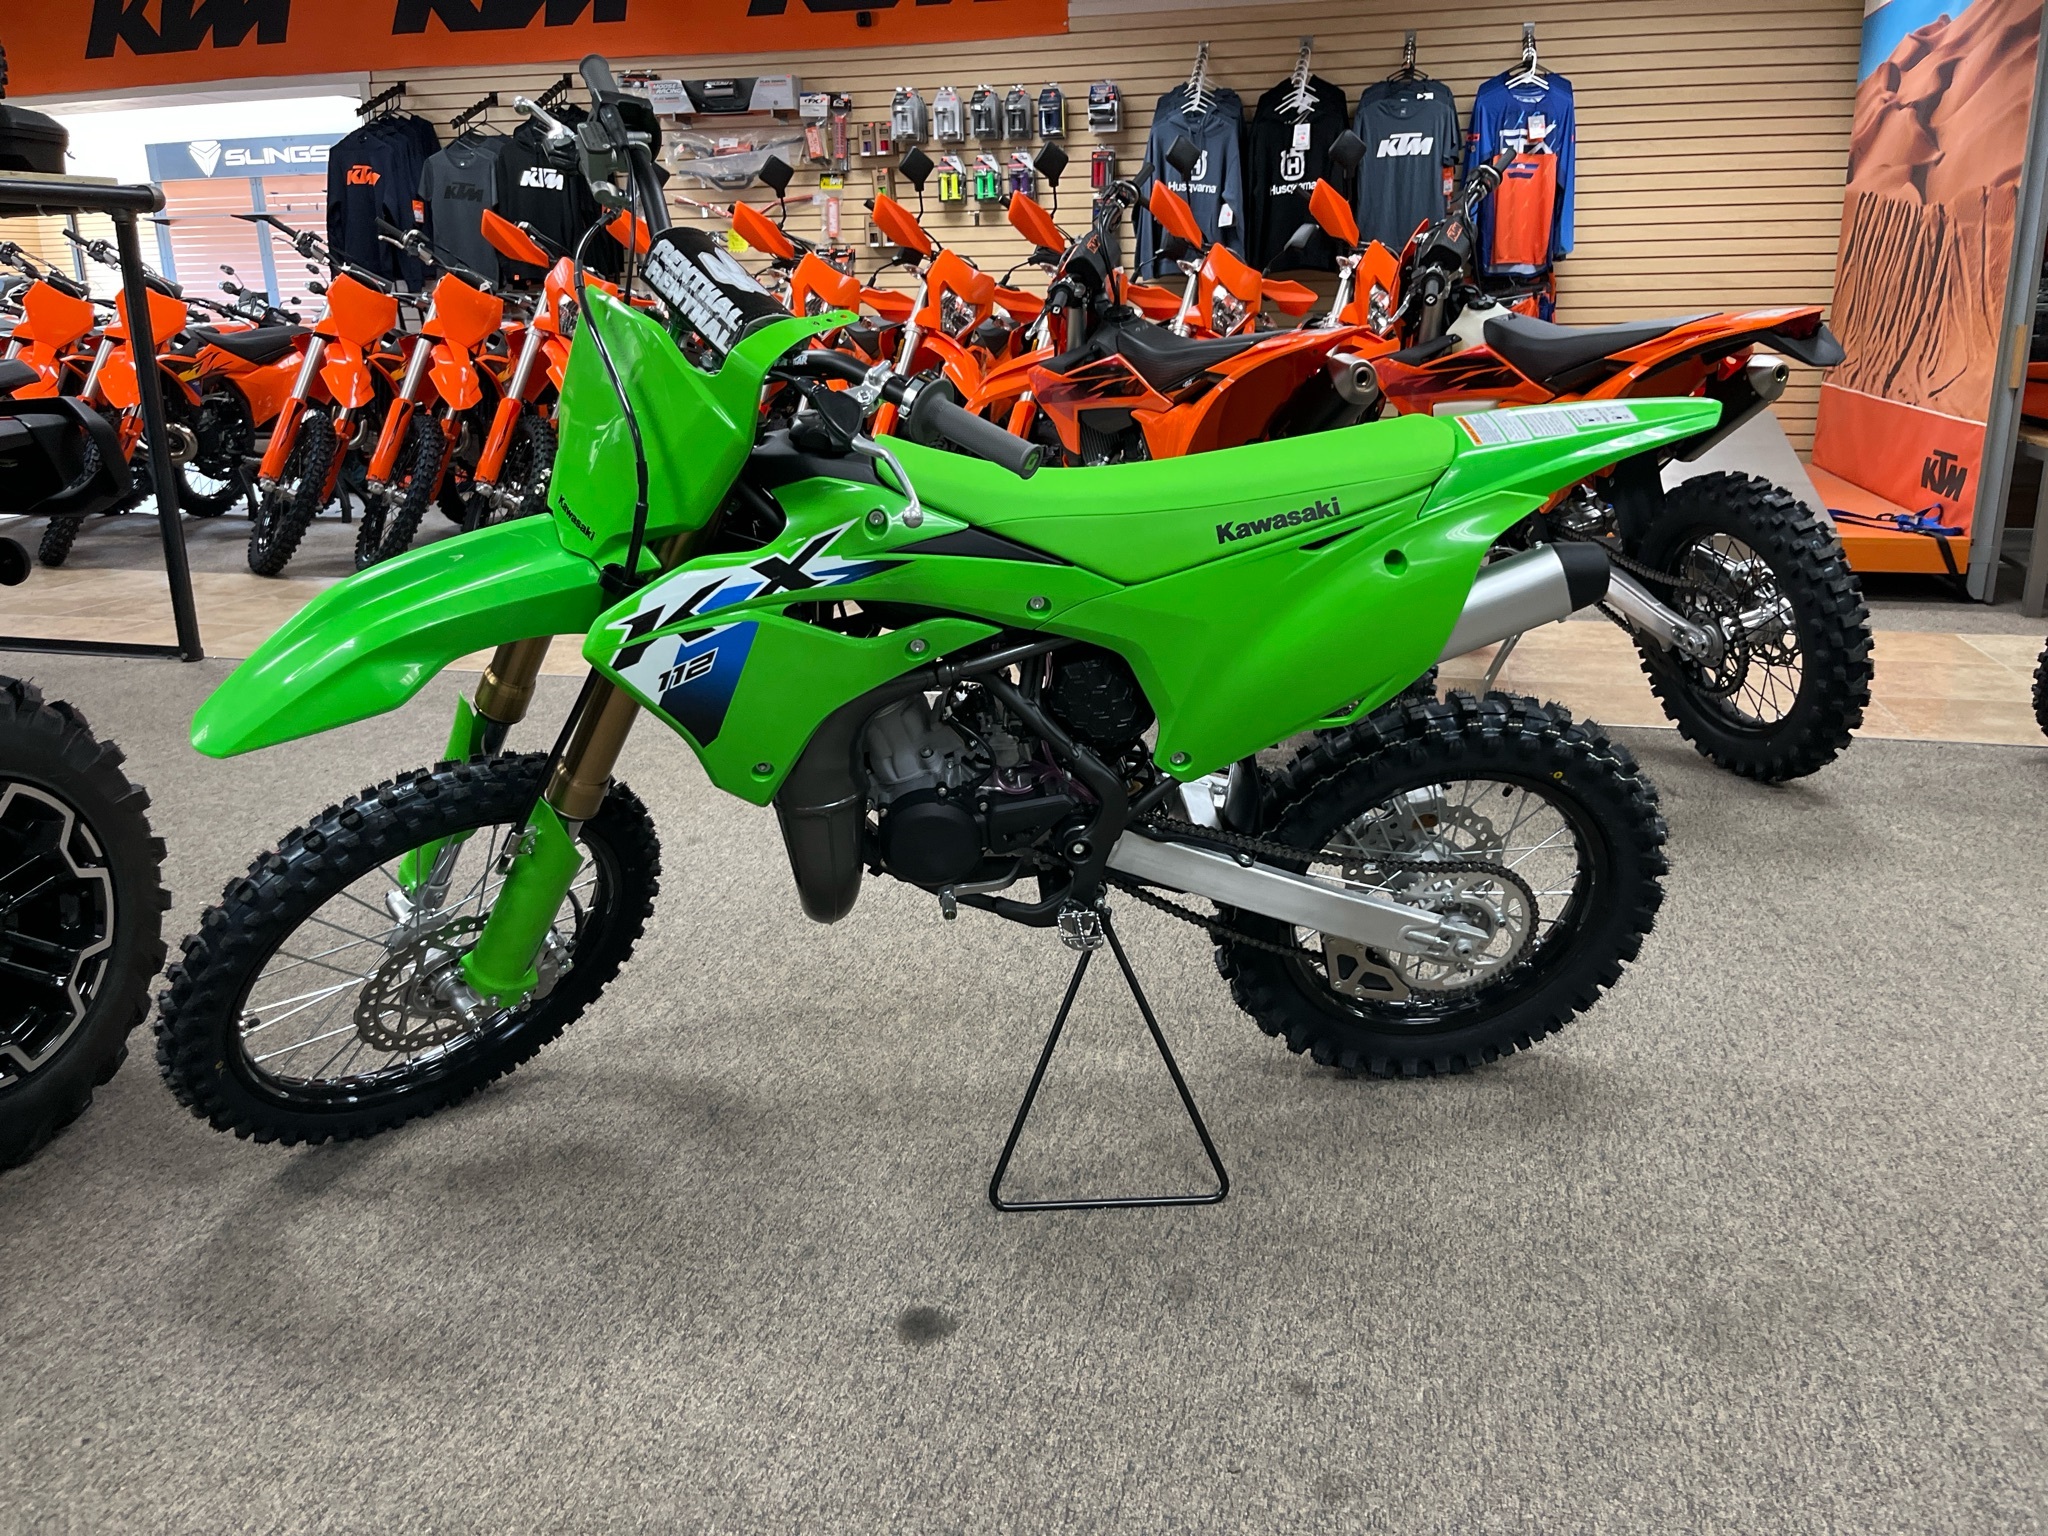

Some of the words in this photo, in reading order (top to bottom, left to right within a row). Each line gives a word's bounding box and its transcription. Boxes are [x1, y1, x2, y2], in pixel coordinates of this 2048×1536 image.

[1376, 132, 1434, 158] KTM
[346, 164, 381, 186] KTM
[444, 182, 484, 202] KTM
[520, 167, 564, 190] KTM
[644, 260, 731, 356] RENTHAL
[651, 238, 743, 332] RENTHAL
[1921, 449, 1968, 502] KTM
[558, 494, 596, 541] Kawasaki
[1215, 496, 1341, 545] Kawasaki
[657, 647, 718, 692] 112
